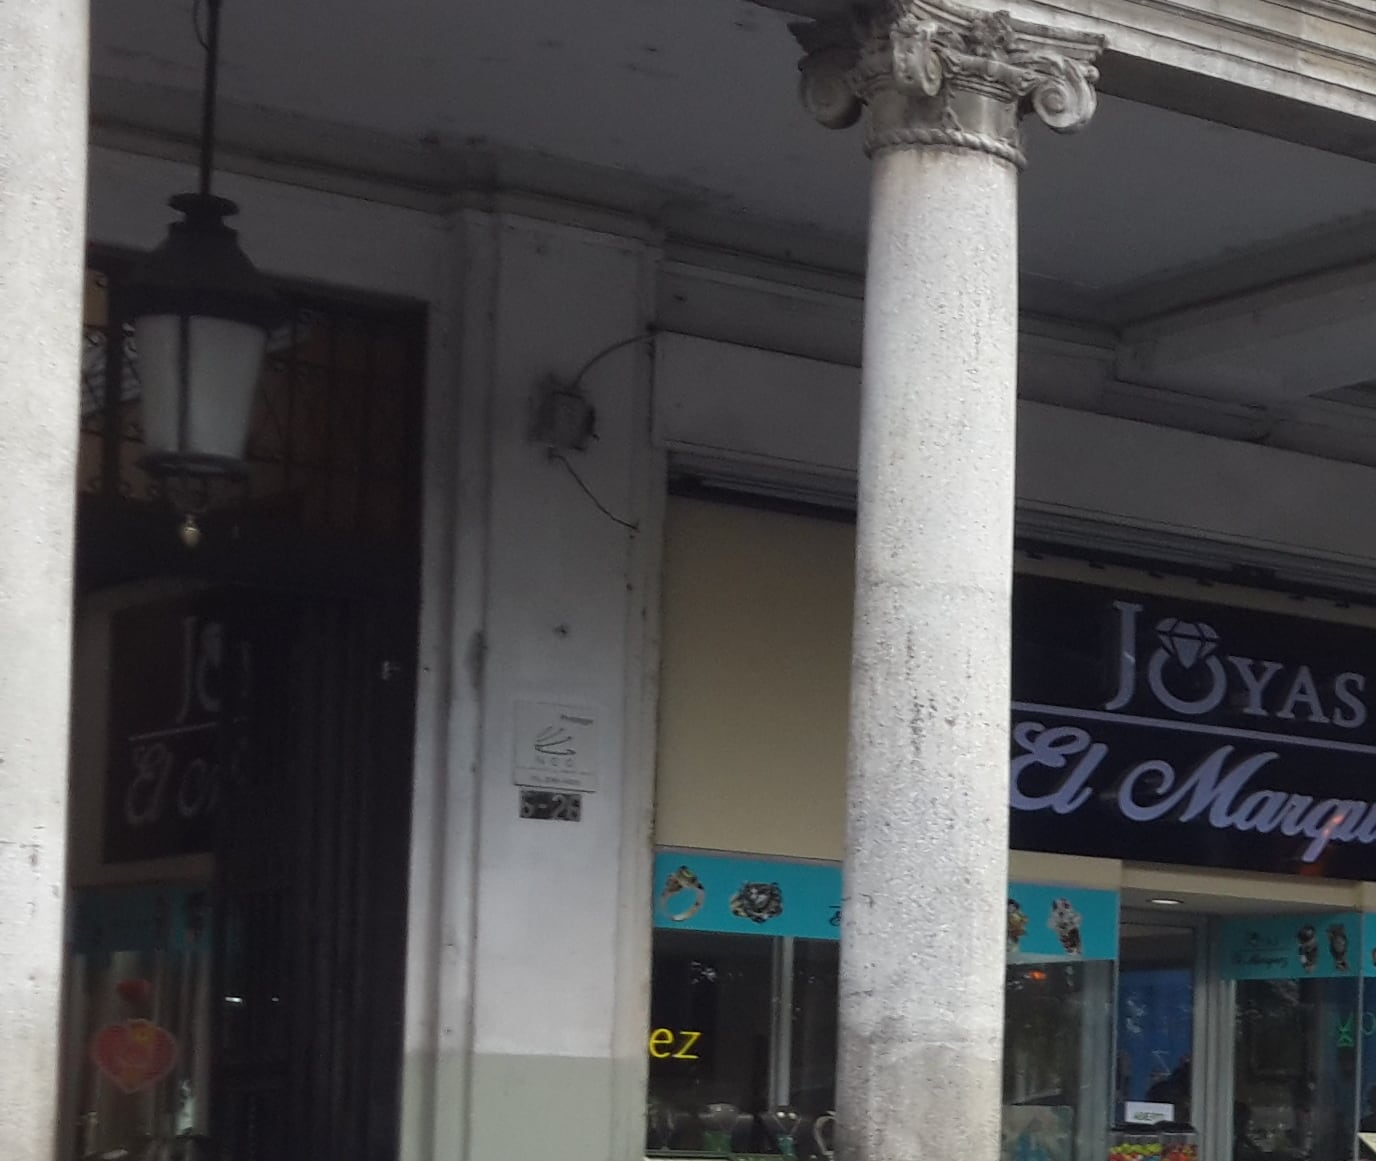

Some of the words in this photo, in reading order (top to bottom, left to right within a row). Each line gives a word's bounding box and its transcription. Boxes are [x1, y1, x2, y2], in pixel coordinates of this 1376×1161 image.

[1106, 601, 1368, 729] JOYAS
[1009, 721, 1108, 814] El
[649, 1028, 701, 1058] ez
